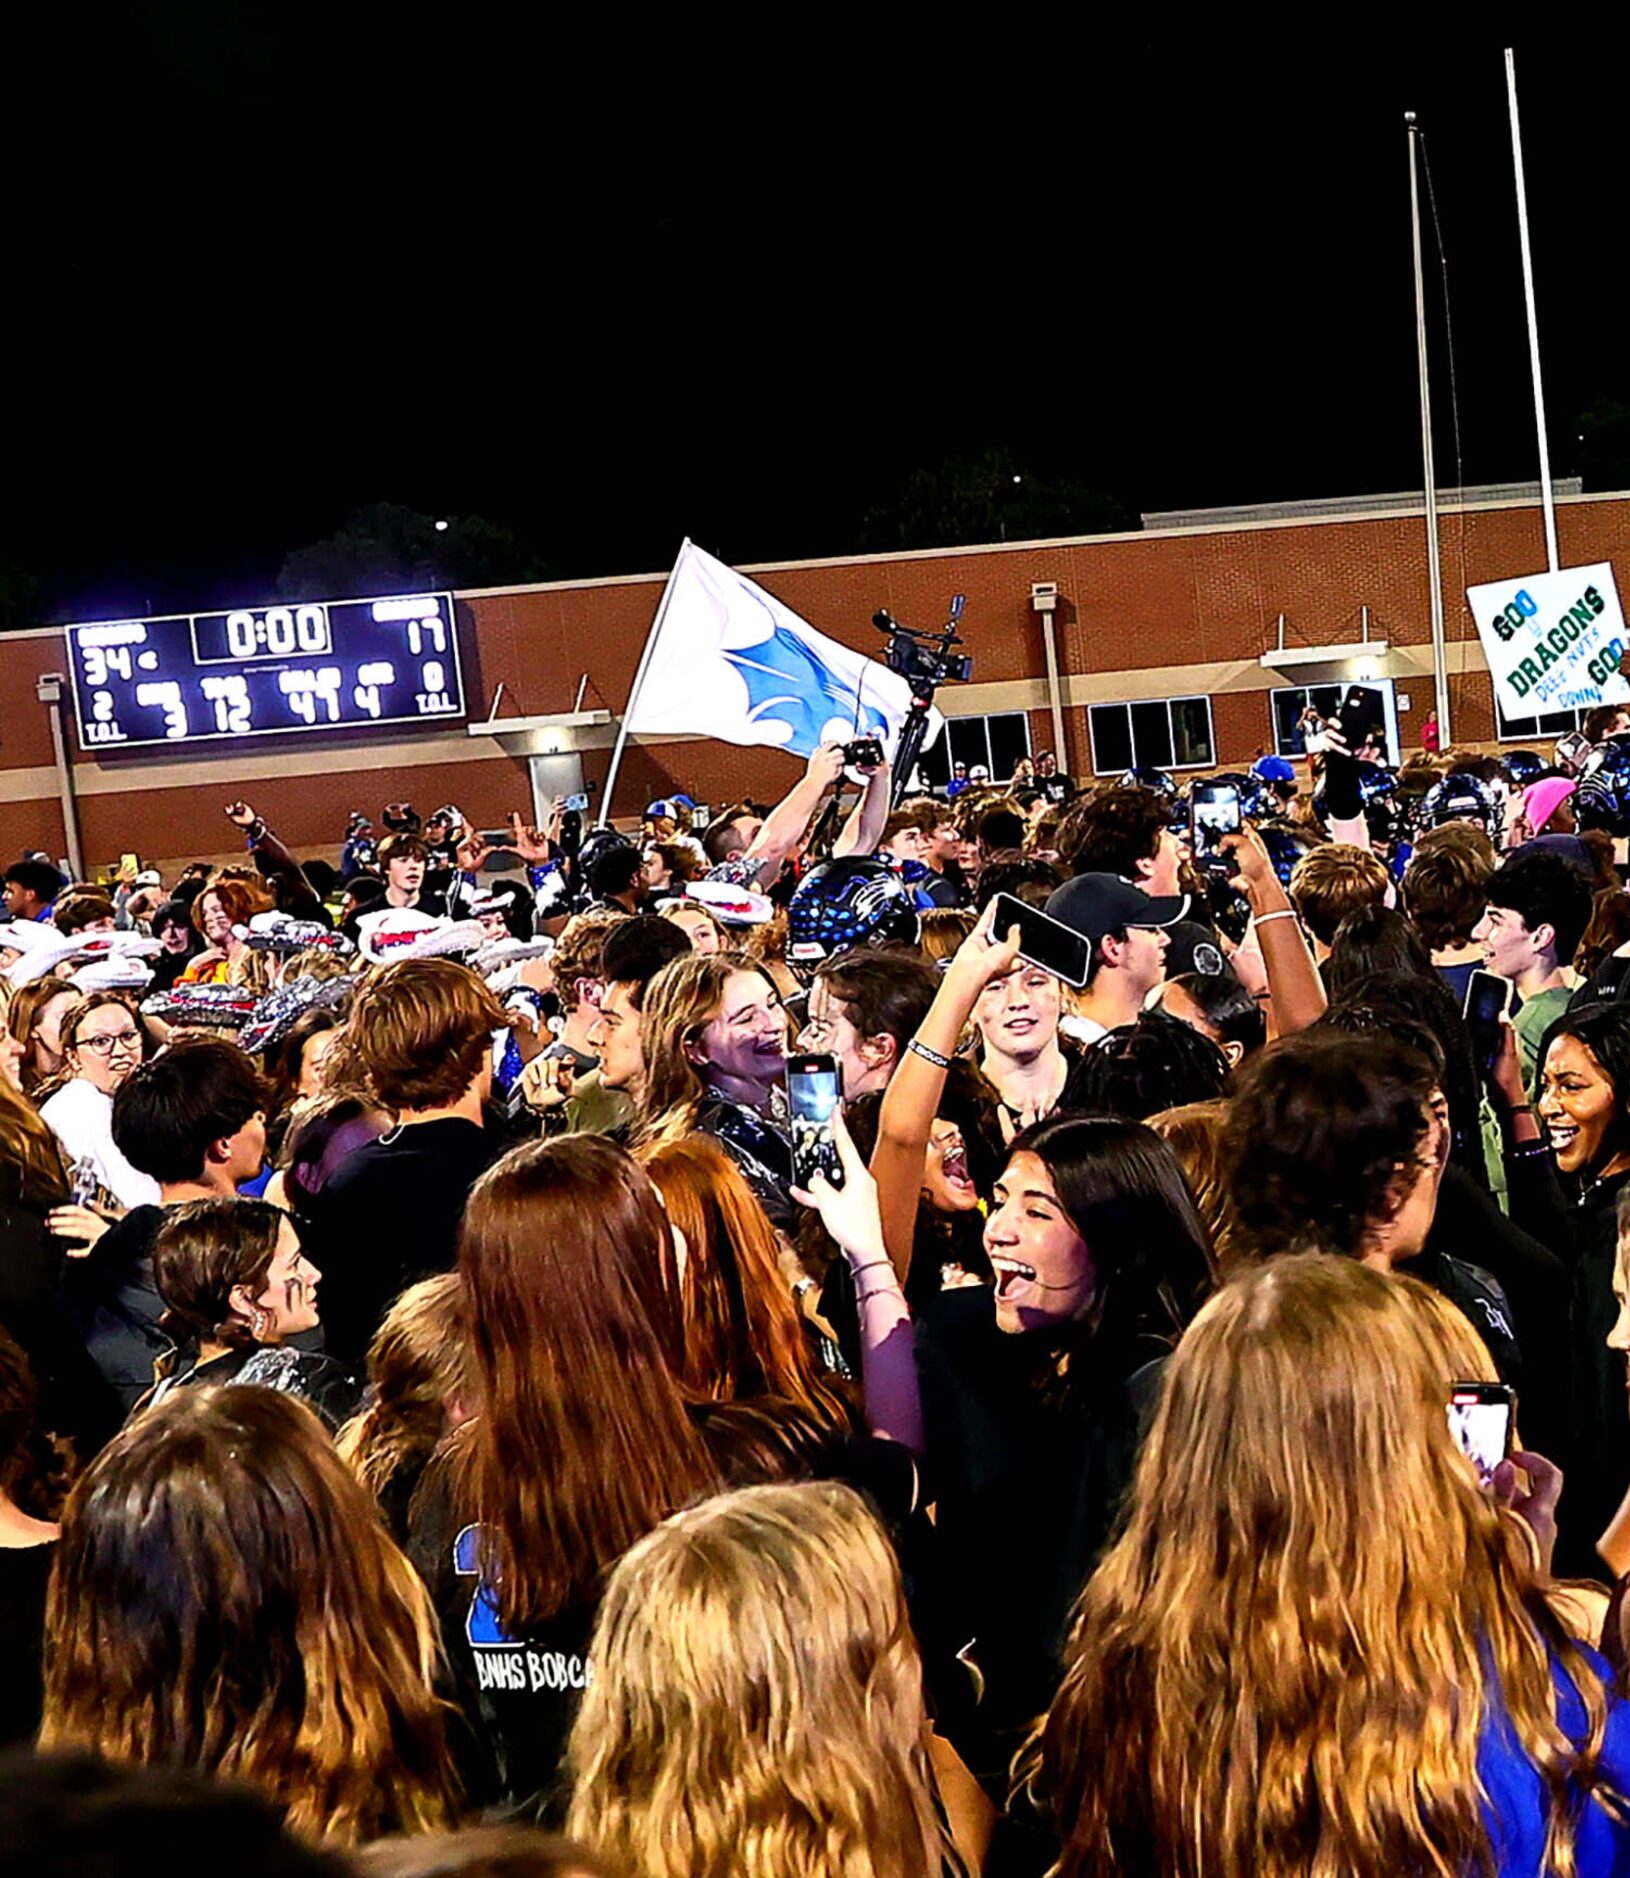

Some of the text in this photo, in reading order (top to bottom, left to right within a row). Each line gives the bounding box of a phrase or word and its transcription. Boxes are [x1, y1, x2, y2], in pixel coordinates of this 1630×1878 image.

[227, 605, 327, 657] 0:00
[1492, 589, 1538, 641] GOO
[408, 617, 446, 654] 17
[1506, 586, 1605, 698] DRAGONS
[82, 646, 132, 685] 34
[422, 661, 444, 692] 0
[93, 690, 113, 721] 2
[354, 685, 381, 718] 4
[473, 1651, 526, 1690] BNHS
